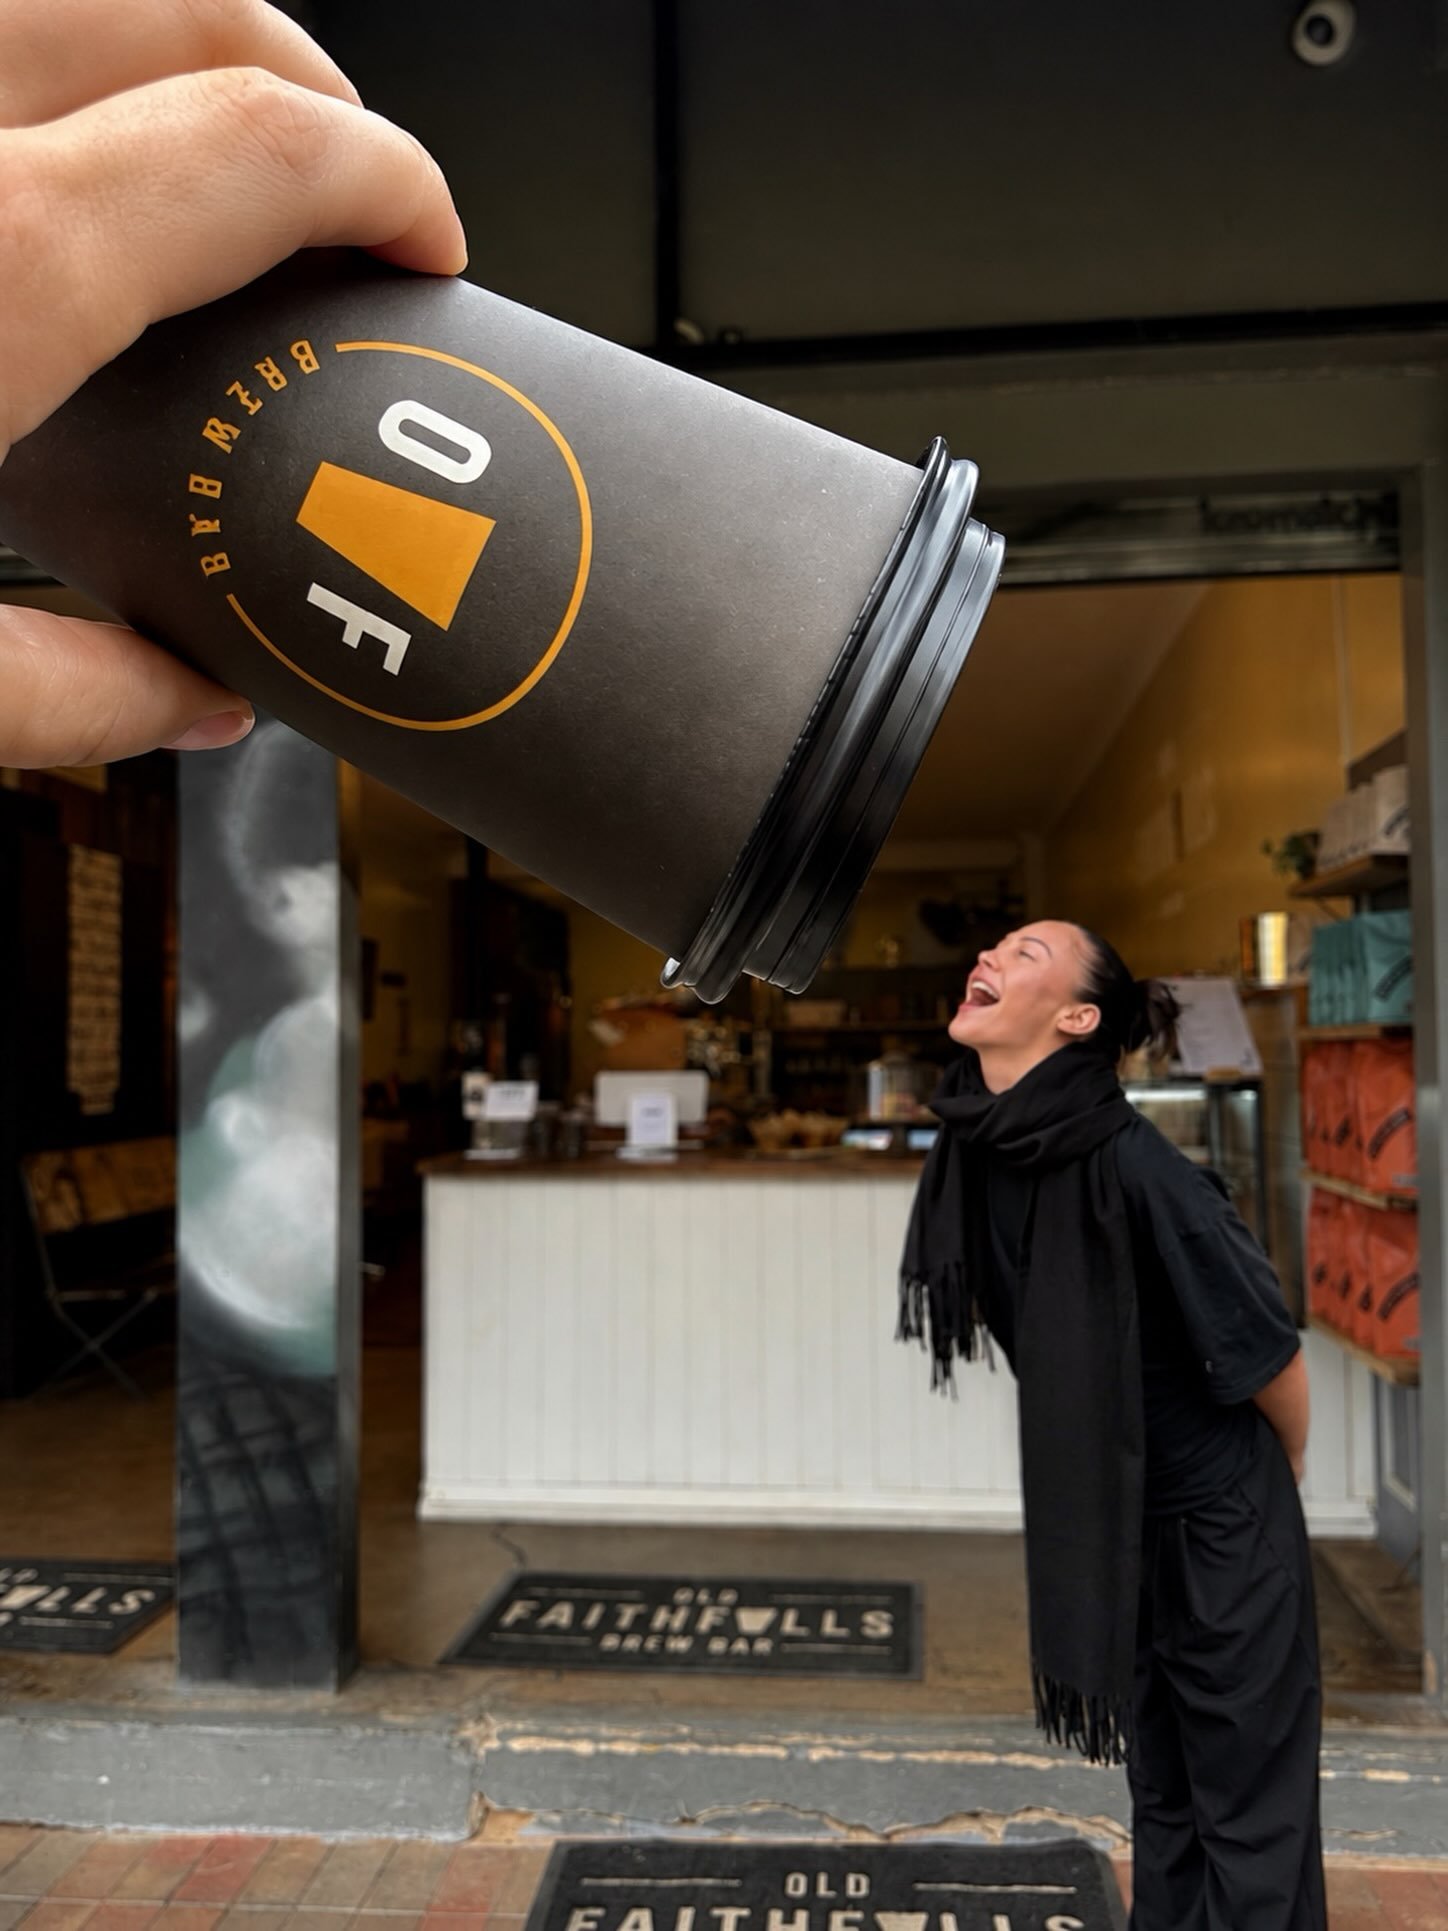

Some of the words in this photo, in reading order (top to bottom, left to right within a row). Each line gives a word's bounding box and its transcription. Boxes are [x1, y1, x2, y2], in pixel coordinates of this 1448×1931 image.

[672, 1586, 739, 1606] OLD
[600, 1632, 695, 1654] BREW
[706, 1635, 773, 1656] BAR
[784, 1871, 870, 1898] OLD
